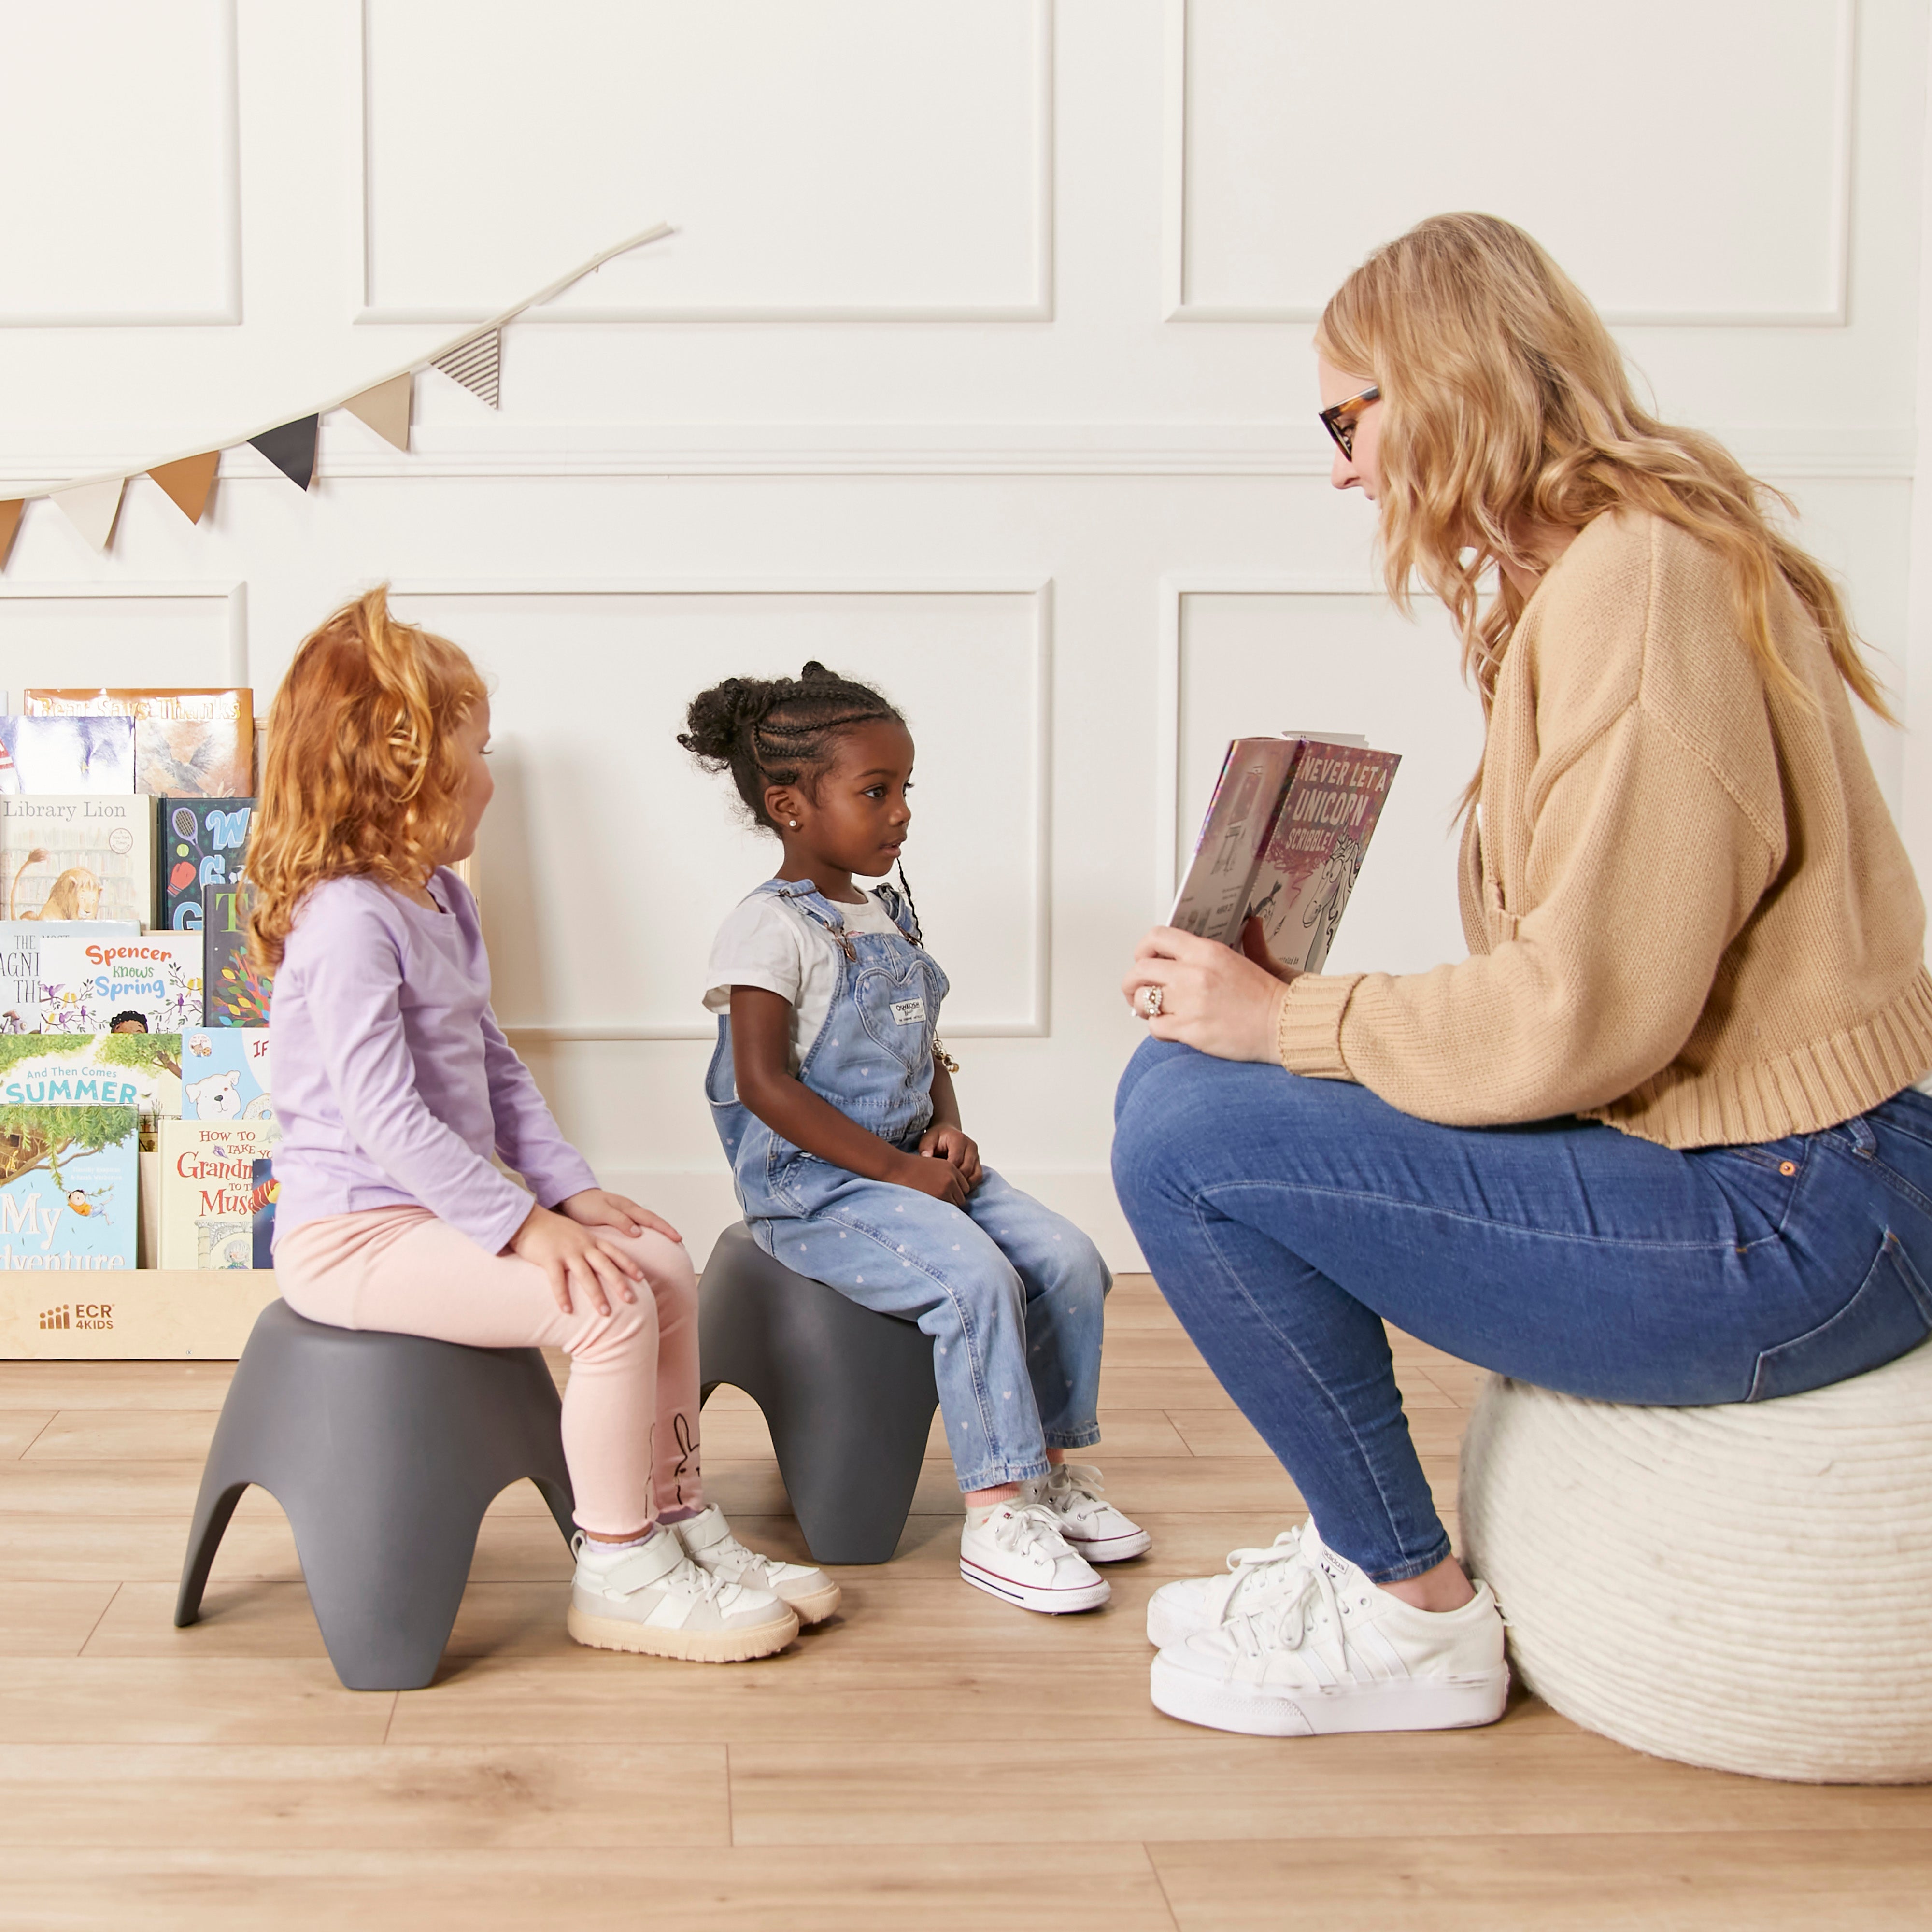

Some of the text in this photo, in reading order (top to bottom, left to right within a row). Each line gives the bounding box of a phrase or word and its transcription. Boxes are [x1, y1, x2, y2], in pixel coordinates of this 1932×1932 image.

[156, 696, 241, 720] Thanks
[1300, 756, 1387, 792] NEVER LET A
[3, 801, 127, 822] Library Lion
[1292, 788, 1369, 827] UNICORN
[1285, 828, 1335, 854] SCRIBBLE!
[14, 935, 36, 950] THE
[85, 945, 172, 966] Spencer
[95, 976, 165, 1001] Spring
[253, 1040, 269, 1058] IF
[27, 1066, 117, 1079] And Then Comes
[6, 1080, 137, 1104] SUMMER
[199, 1130, 256, 1142] HOW TO
[227, 1144, 256, 1155] TAKE
[229, 1183, 242, 1191] TO
[0, 1193, 64, 1250] My
[76, 1304, 112, 1318] ECR
[76, 1320, 114, 1330] 4KIDS
